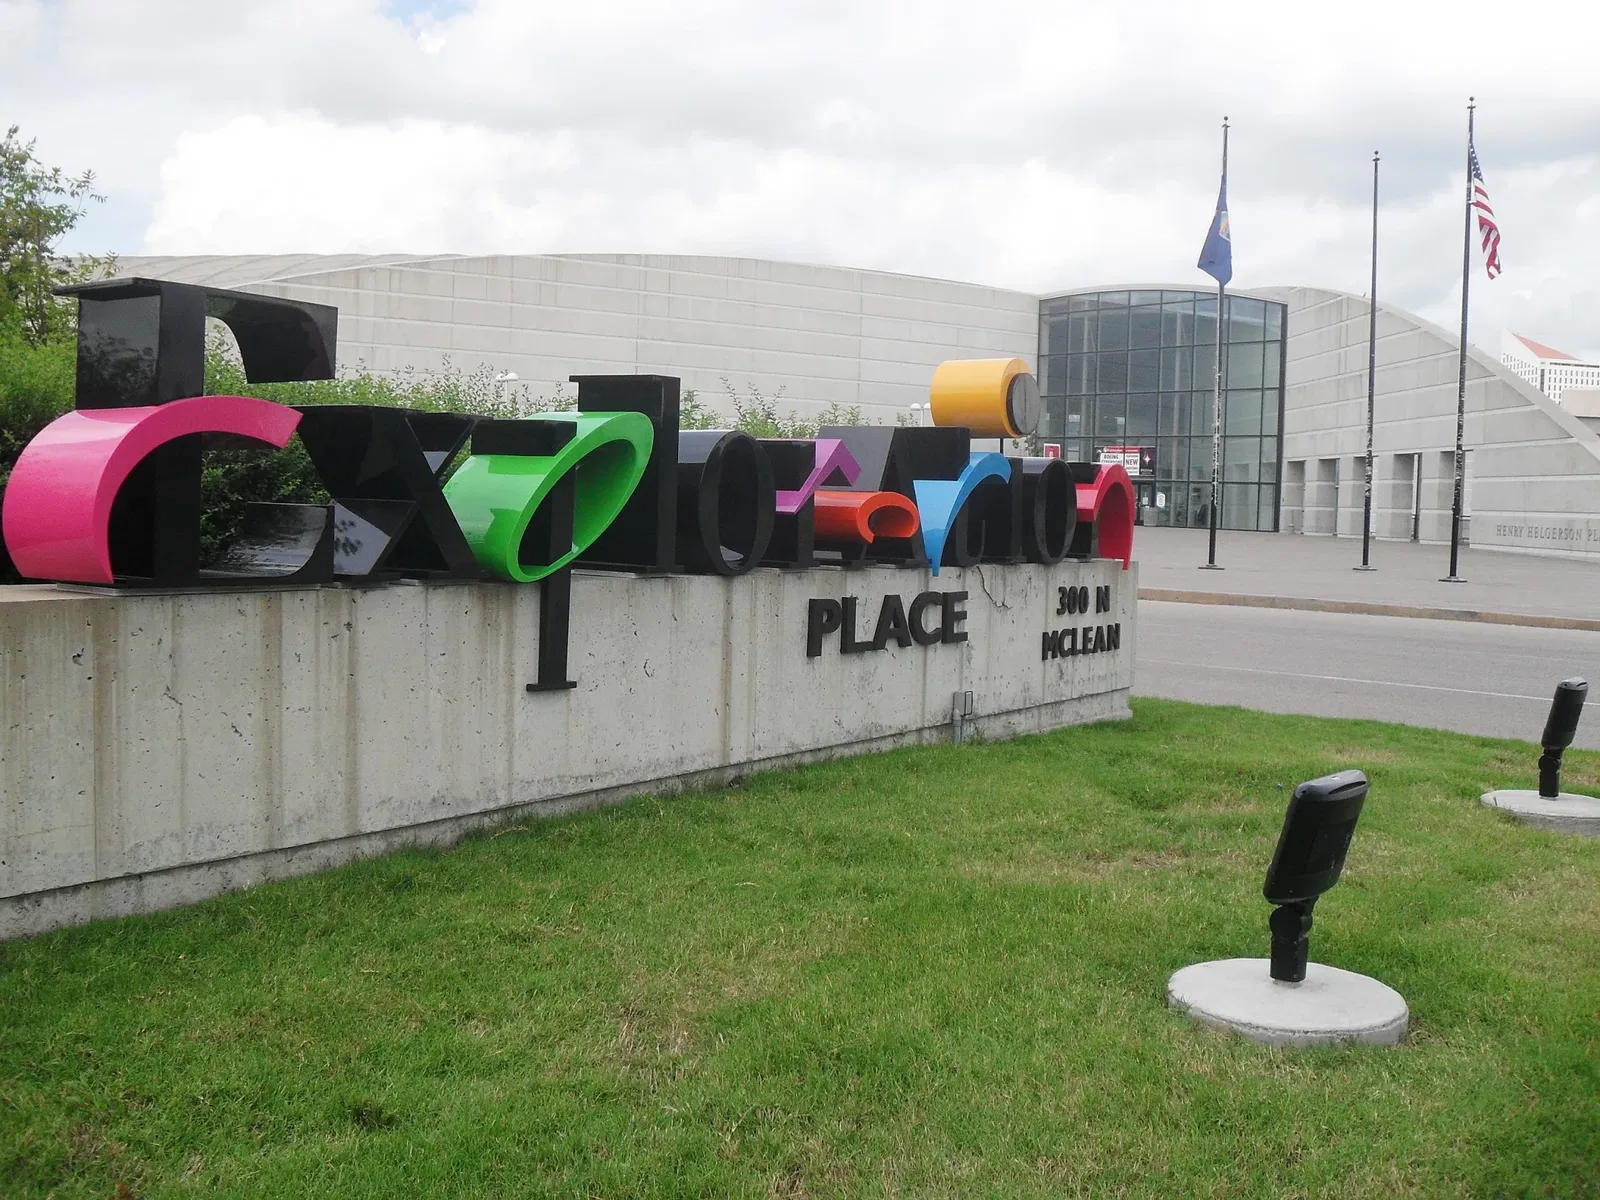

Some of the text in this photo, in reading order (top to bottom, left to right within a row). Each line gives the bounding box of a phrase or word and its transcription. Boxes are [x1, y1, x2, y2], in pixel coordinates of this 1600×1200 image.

[1496, 525, 1600, 541] HENRY HELGERSON PL
[1056, 585, 1111, 616] 300 N
[806, 590, 969, 658] PLACE
[1042, 623, 1121, 661] MCLEAN
